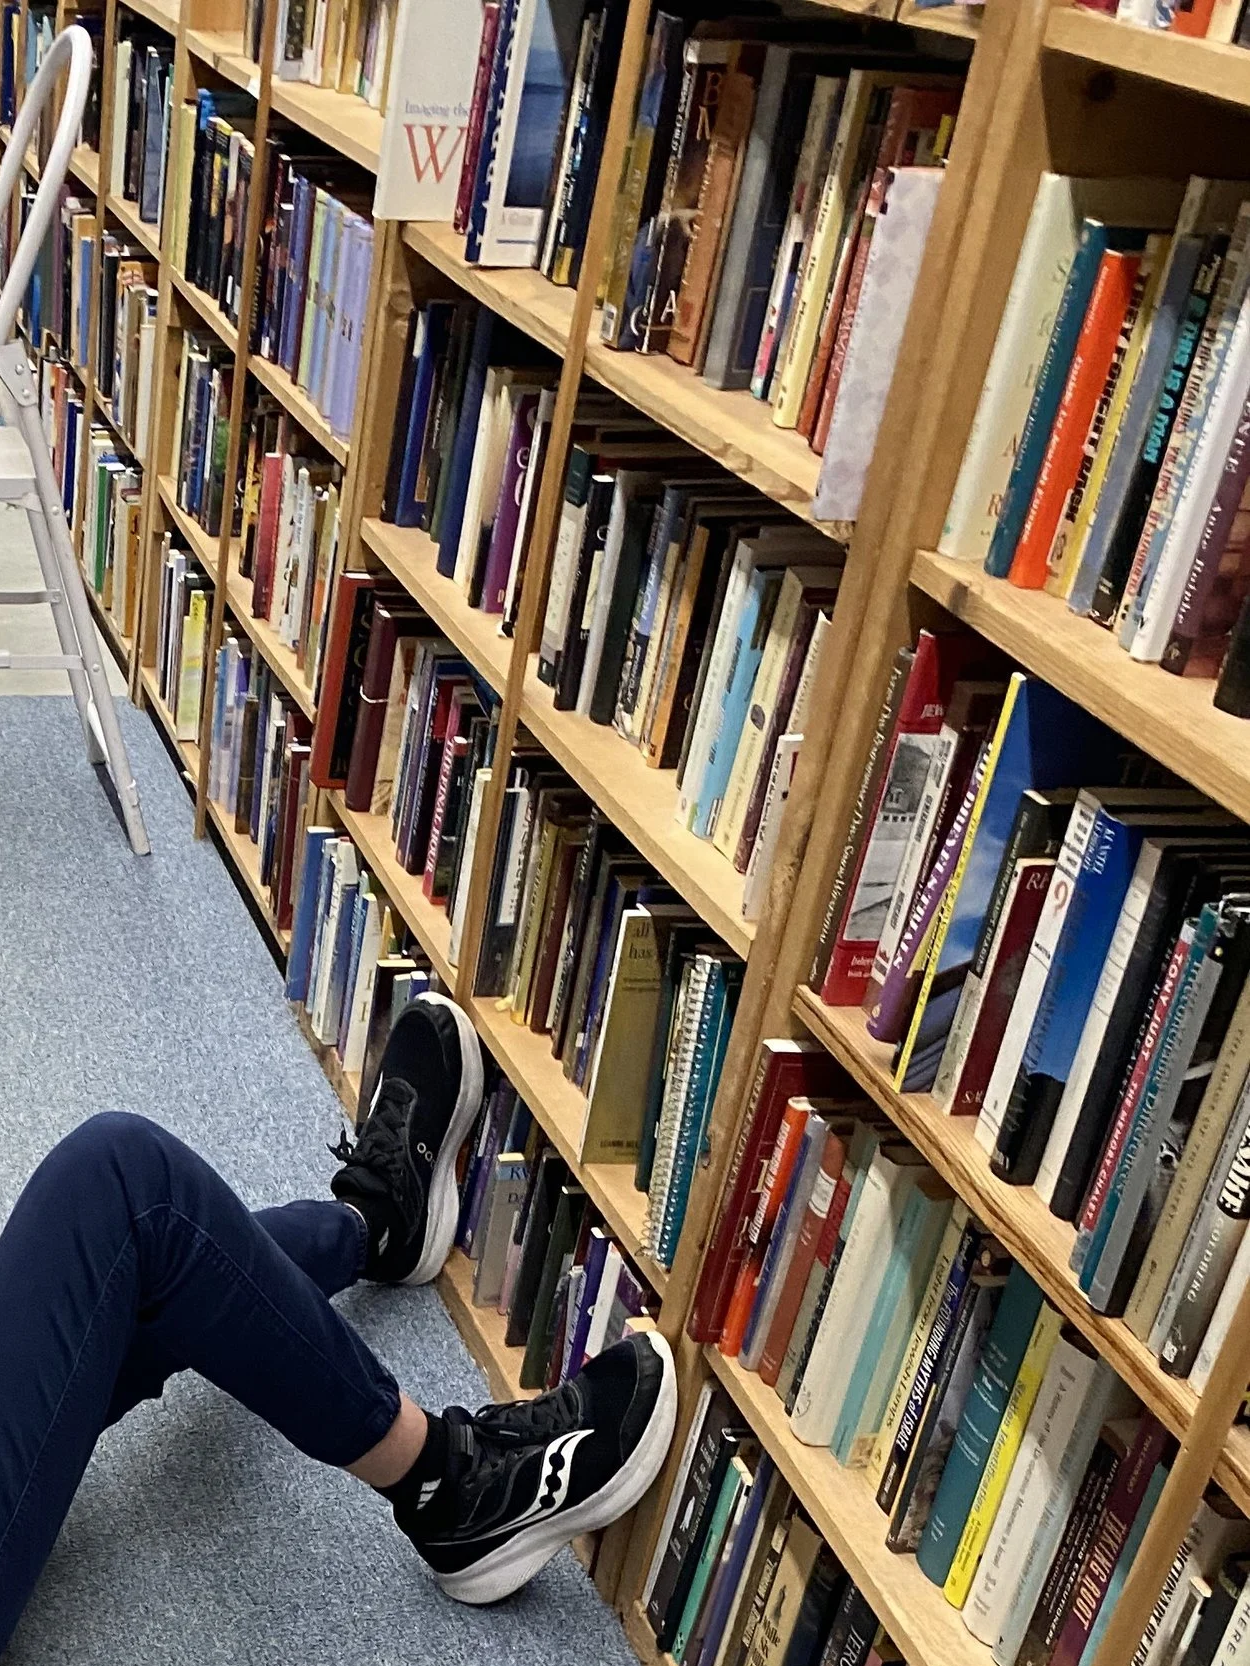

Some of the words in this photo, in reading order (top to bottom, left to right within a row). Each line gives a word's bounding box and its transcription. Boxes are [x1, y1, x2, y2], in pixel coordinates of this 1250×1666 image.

[405, 100, 449, 118] Imaging
[1200, 500, 1222, 551] Anne
[440, 738, 455, 774] THE
[430, 774, 450, 826] FINAL
[423, 825, 441, 874] HOUR
[1157, 950, 1183, 1007] TONY
[1139, 1009, 1164, 1062] JUDT
[1123, 1079, 1139, 1108] THE
[1102, 1108, 1130, 1167] MEMORY
[1084, 1166, 1110, 1221] CHALET
[931, 1254, 950, 1292] Light
[943, 1281, 959, 1305] The
[917, 1292, 937, 1333] from
[926, 1302, 951, 1358] FOUNDING
[899, 1330, 925, 1385] Jewish
[911, 1353, 935, 1403] MYTHS
[884, 1380, 908, 1429] Lamps
[896, 1411, 917, 1451] ISRAEL
[1088, 1510, 1127, 1583] TAKING
[1042, 1560, 1081, 1647] EXECUTIONERS
[1068, 1573, 1102, 1632] ROOT
[762, 1615, 781, 1647] While
[1224, 1601, 1250, 1656] HERE
